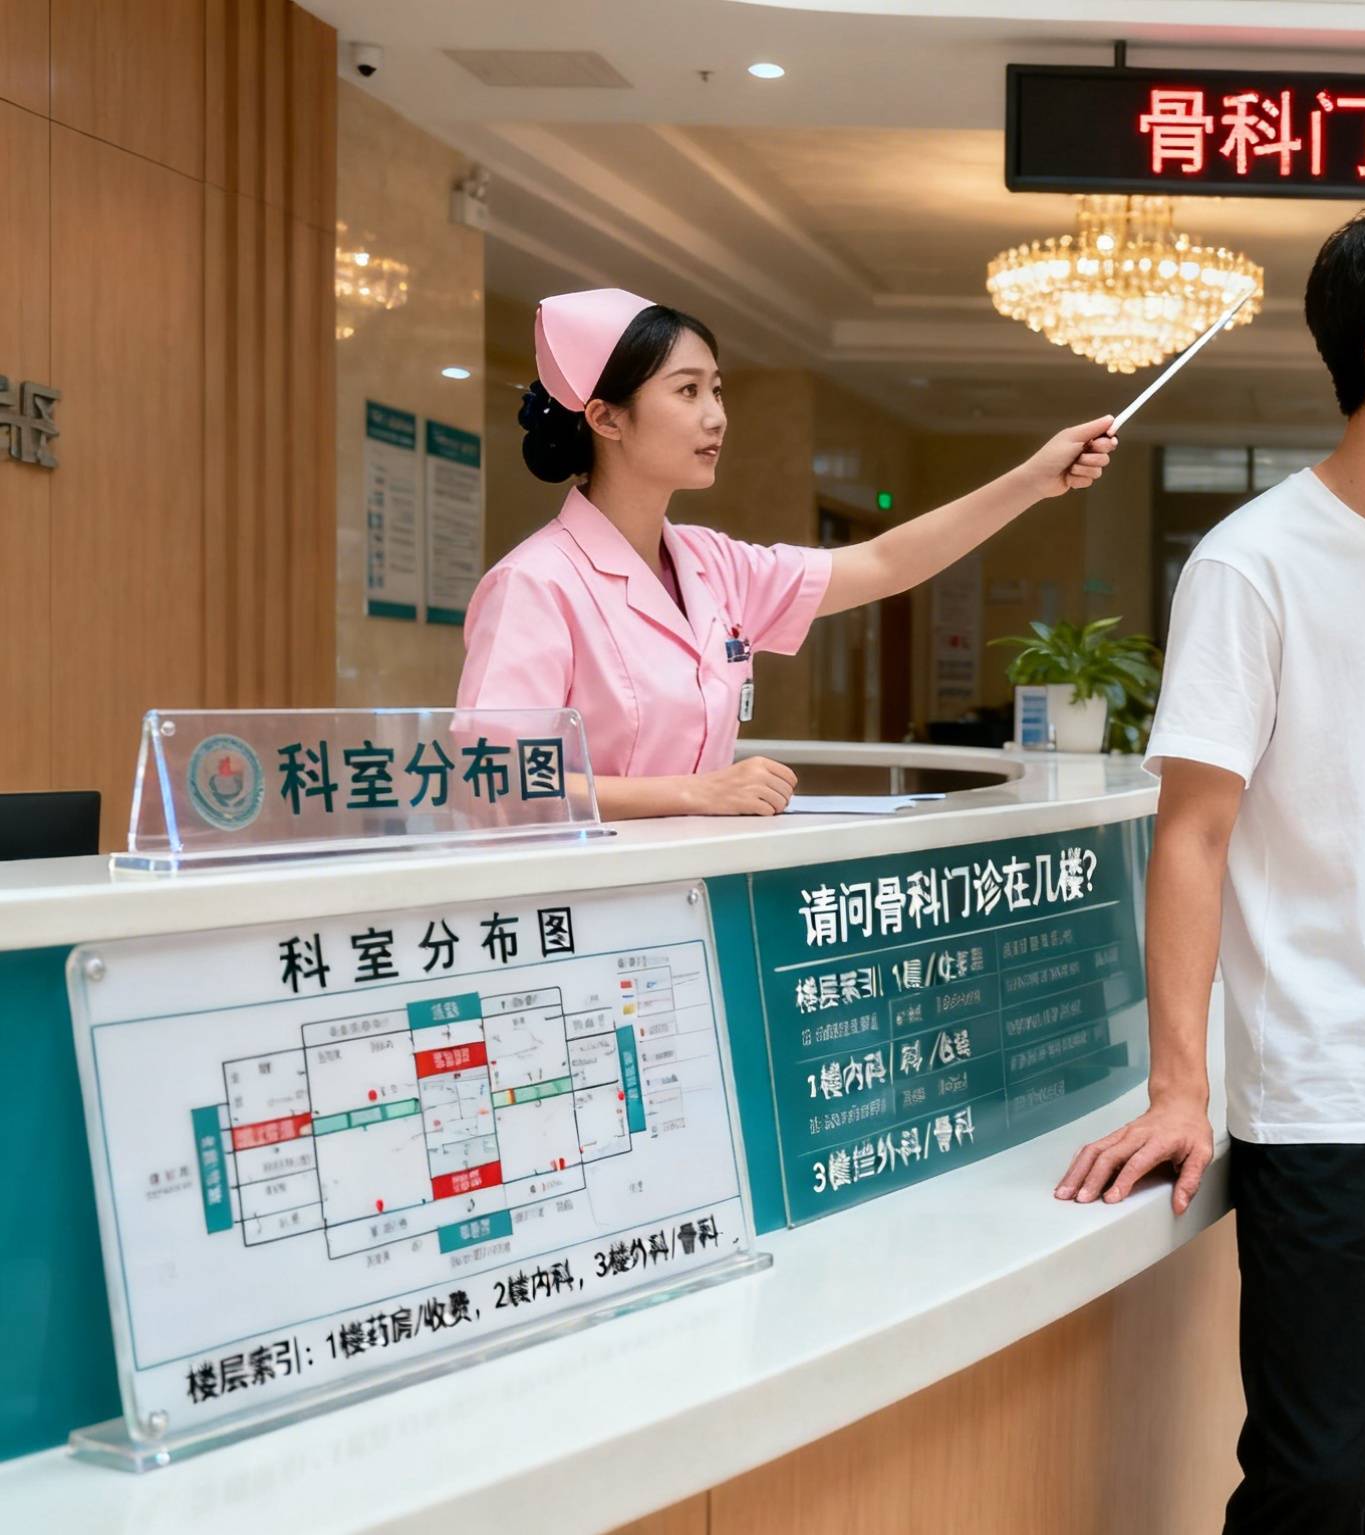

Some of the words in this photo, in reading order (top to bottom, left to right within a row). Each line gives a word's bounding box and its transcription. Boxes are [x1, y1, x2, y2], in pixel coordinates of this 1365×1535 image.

[278, 737, 566, 815] 科室分布图
[279, 906, 576, 993] 科室分布图
